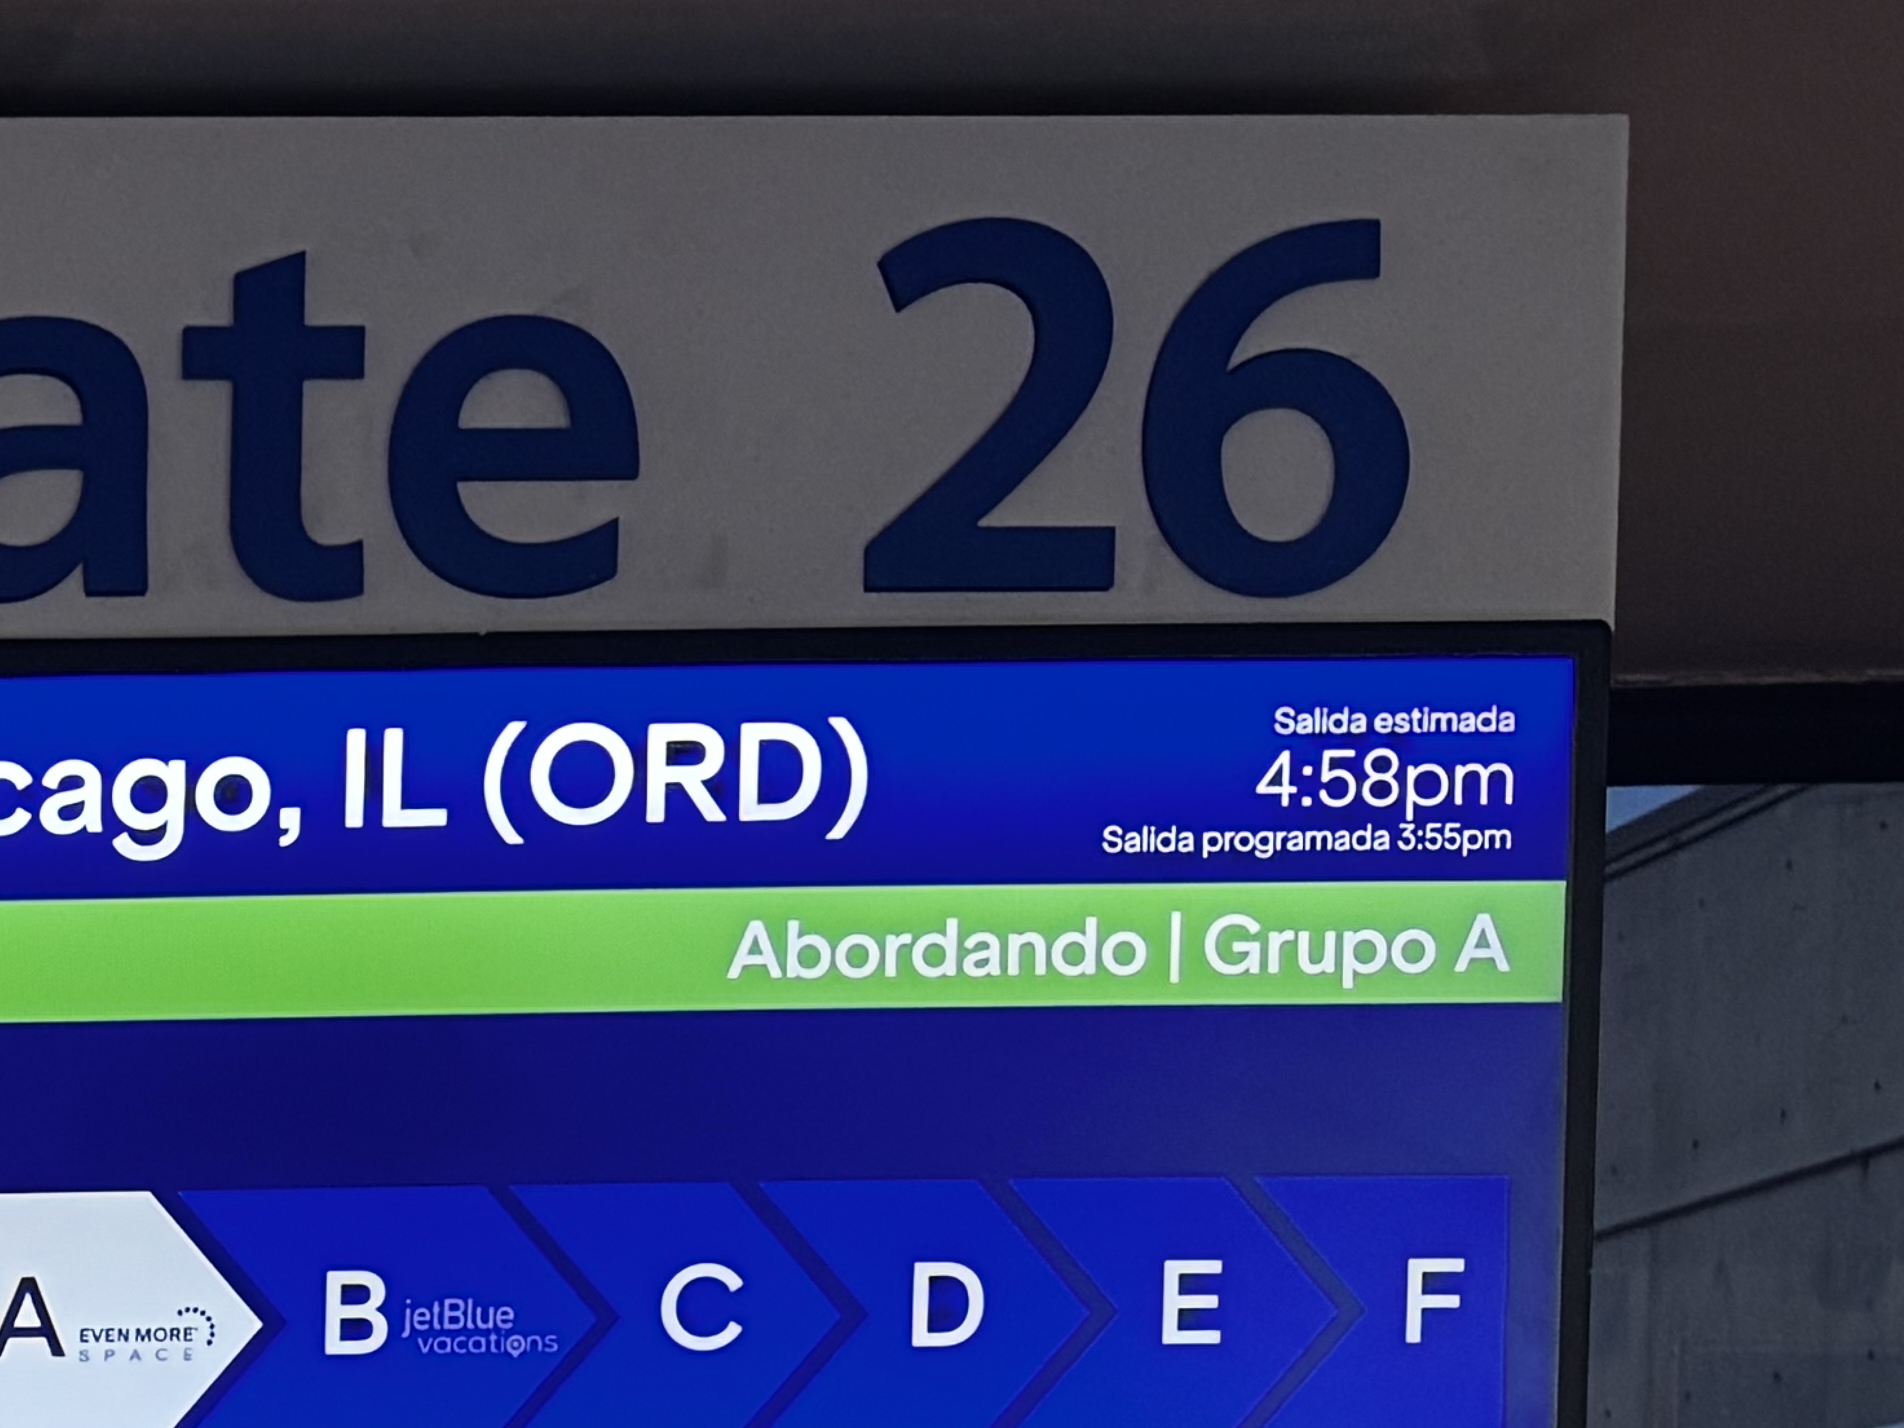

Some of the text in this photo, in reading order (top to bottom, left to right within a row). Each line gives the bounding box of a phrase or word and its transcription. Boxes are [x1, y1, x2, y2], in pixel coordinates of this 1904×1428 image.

[863, 217, 1410, 598] 26
[1275, 705, 1515, 734] Salida estimada
[345, 728, 447, 828] IL
[484, 717, 867, 844] (ORD)
[1256, 748, 1513, 820] 4:58pm
[1102, 819, 1511, 858] Salida programada 3:55pm
[727, 917, 1147, 979] Abordando
[1205, 914, 1436, 989] Grupo
[1455, 913, 1510, 972] A
[80, 1327, 193, 1343] EVEN MORE
[325, 1271, 388, 1355] B
[401, 1298, 515, 1338] jetBlue
[661, 1263, 743, 1351] C
[912, 1262, 984, 1347] D
[1162, 1260, 1222, 1344] E
[1406, 1258, 1464, 1343] F
[79, 1348, 192, 1362] SPACE
[417, 1330, 559, 1358] vacations
